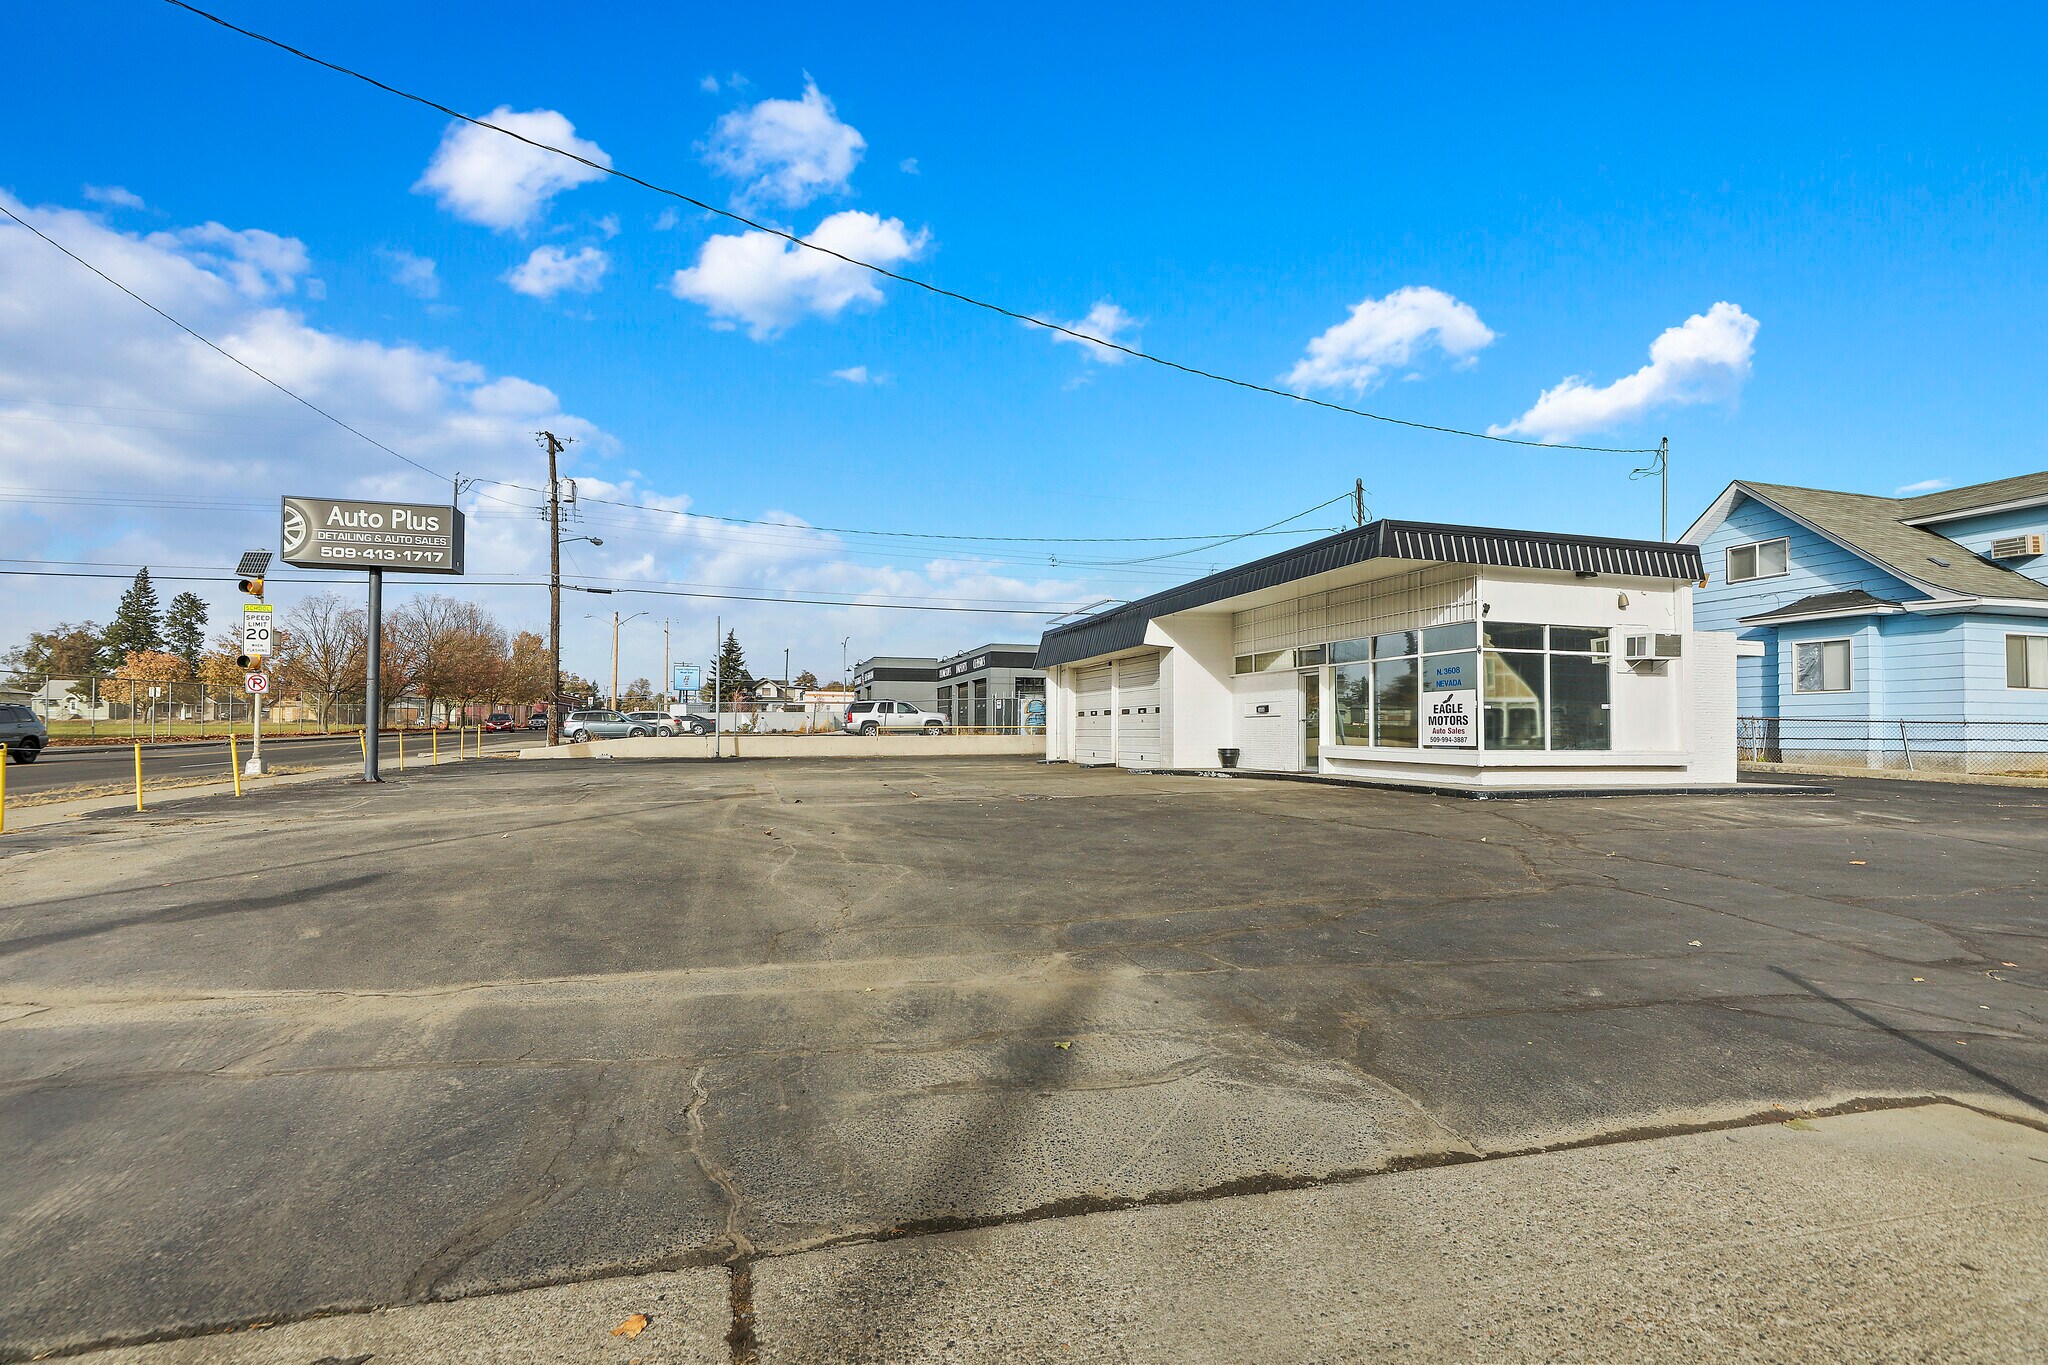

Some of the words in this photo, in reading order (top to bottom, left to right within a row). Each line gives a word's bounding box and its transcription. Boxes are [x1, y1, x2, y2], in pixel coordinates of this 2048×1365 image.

[326, 505, 384, 529] Auto
[391, 509, 440, 532] Plus
[317, 531, 372, 542] DETAILING
[374, 534, 382, 543] &
[384, 535, 413, 544] AUTO
[414, 537, 447, 546] SALES
[246, 628, 269, 640] 20
[1443, 666, 1461, 675] 3608
[1436, 679, 1462, 687] NEVADA
[1433, 703, 1463, 714] EAGLE
[1428, 715, 1469, 726] MOTORS
[1447, 727, 1466, 735] Sales
